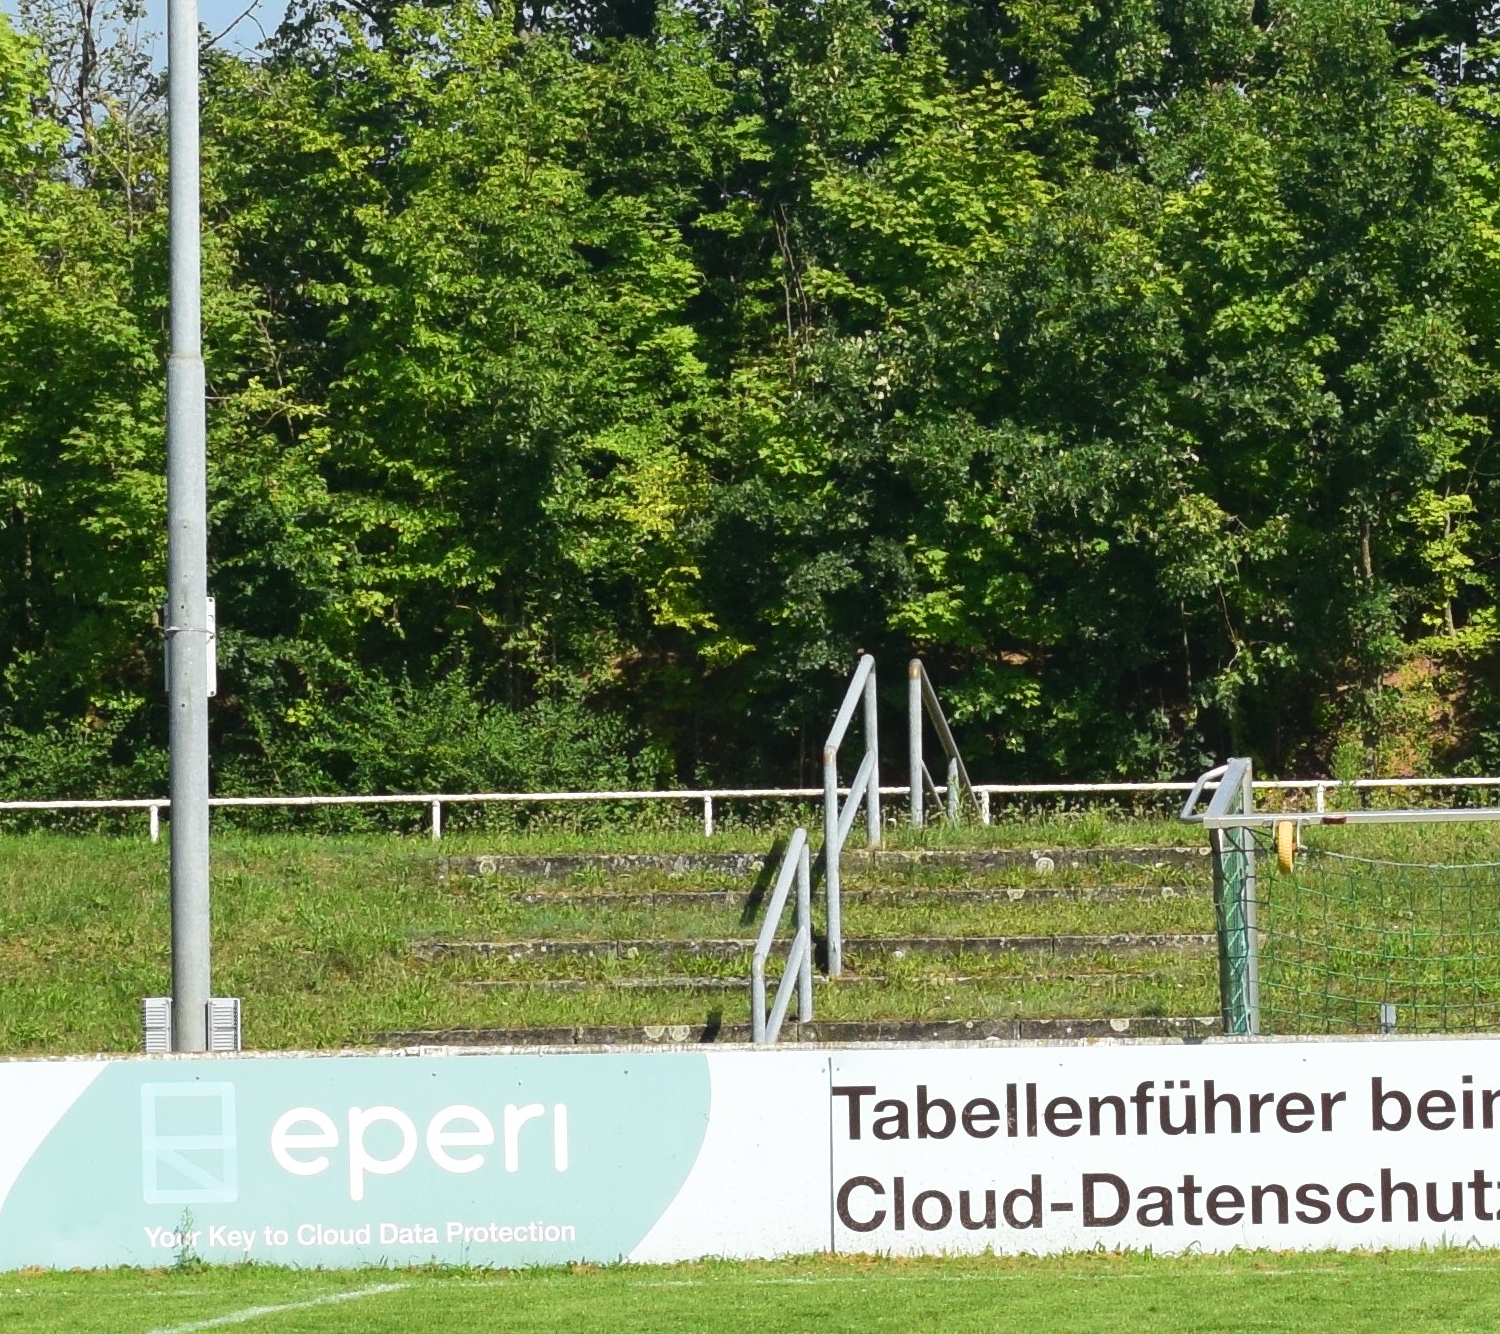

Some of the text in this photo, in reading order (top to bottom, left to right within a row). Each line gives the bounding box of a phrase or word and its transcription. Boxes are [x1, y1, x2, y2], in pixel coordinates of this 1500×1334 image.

[835, 1079, 1347, 1141] Tabellenführer
[270, 1102, 569, 1202] eperi
[143, 1220, 576, 1252] Your Key to Cloud Data Protection
